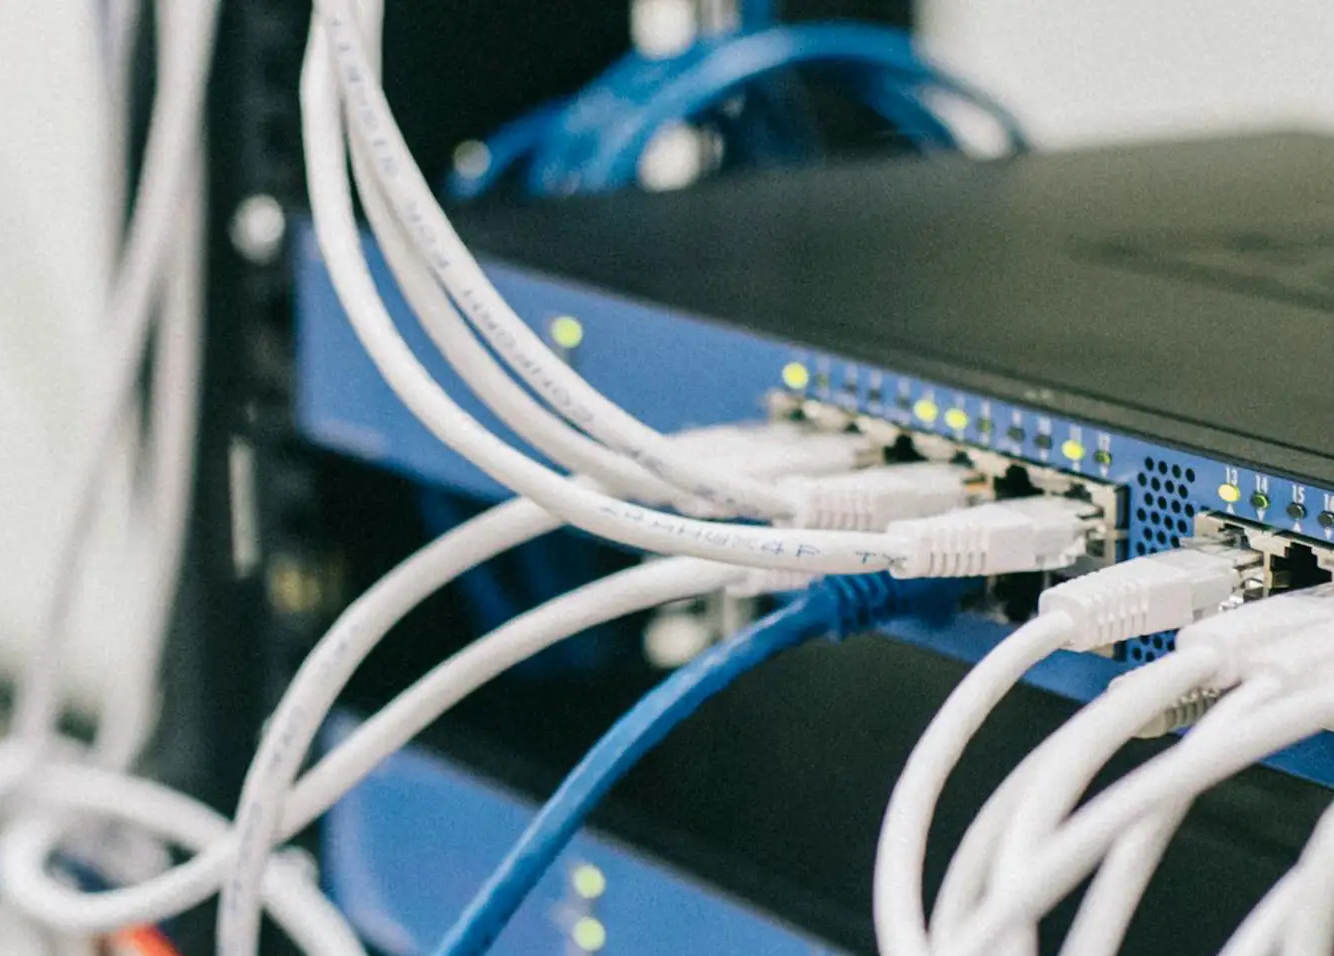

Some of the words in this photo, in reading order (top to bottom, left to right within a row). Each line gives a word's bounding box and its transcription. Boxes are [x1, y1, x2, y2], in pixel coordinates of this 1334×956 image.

[1225, 466, 1239, 486] 13
[1255, 473, 1268, 493] 14
[1292, 484, 1306, 503] 15
